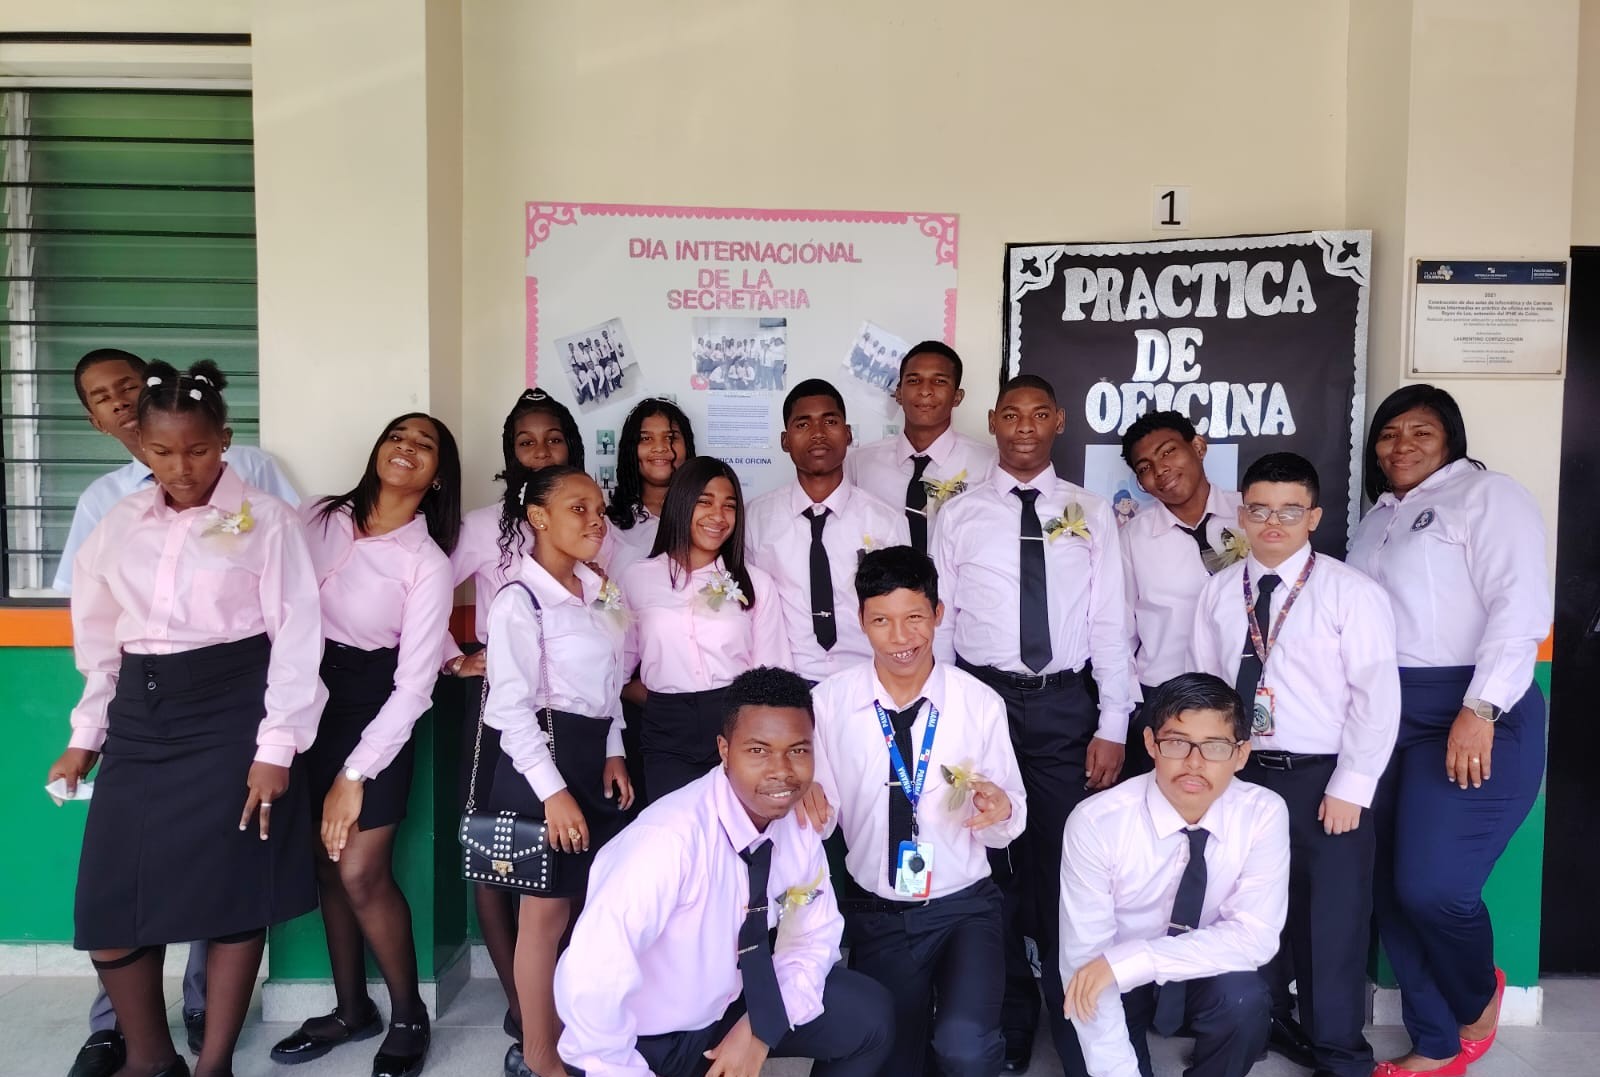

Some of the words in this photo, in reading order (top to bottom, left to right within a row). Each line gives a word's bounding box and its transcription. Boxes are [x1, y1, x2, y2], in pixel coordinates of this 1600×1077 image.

[1160, 190, 1181, 226] 1
[698, 268, 730, 289] DE
[742, 268, 774, 289] LA
[1061, 259, 1317, 322] PRACTICA
[666, 288, 810, 310] SECRETARIA
[1132, 327, 1203, 382] DE
